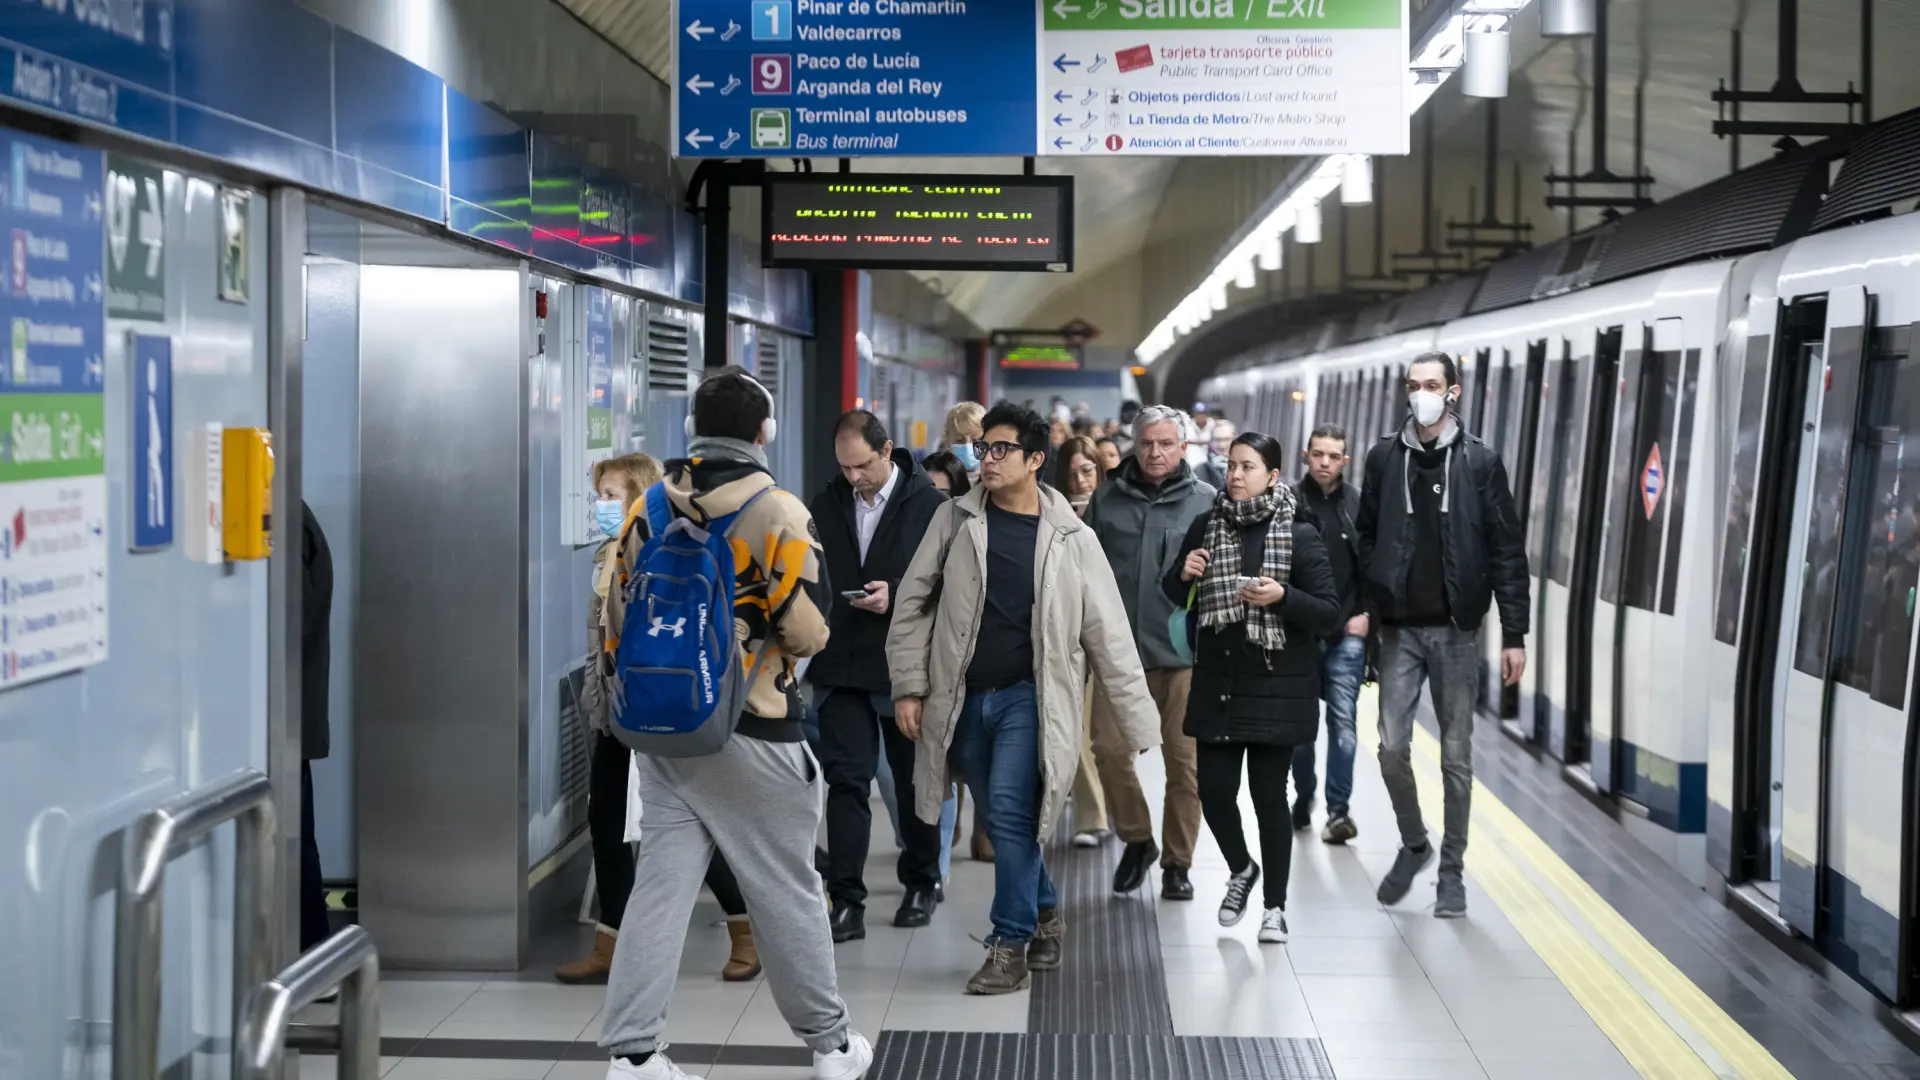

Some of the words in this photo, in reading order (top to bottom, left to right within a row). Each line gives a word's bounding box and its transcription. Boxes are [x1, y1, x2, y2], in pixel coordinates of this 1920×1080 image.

[797, 0, 843, 15] Pinar
[849, 0, 871, 15] de
[764, 5, 779, 36] 1
[797, 25, 902, 41] Valdecarros
[1160, 46, 1206, 60] tarjeta
[1211, 46, 1282, 60] transporte
[1286, 44, 1333, 60] público
[797, 53, 840, 69] Paco
[846, 53, 868, 69] de
[874, 52, 920, 69] Lucía
[760, 58, 783, 90] 9
[1160, 64, 1199, 77] Public
[1204, 64, 1259, 79] Transport
[1263, 63, 1293, 77] Card
[1296, 63, 1333, 77] Office
[797, 79, 871, 98] Arganda
[877, 79, 903, 95] del
[909, 79, 943, 98] Rey
[1128, 91, 1179, 105] Objetos
[1275, 90, 1300, 102] and
[796, 107, 870, 123] Terminal
[876, 107, 967, 123] autobuses
[1128, 113, 1144, 125] La
[1147, 113, 1190, 125] Tienda
[1193, 113, 1209, 125] de
[1277, 113, 1312, 125] Metro
[1314, 112, 1346, 128] Shop
[796, 133, 828, 149] Bus
[833, 133, 899, 149] terminal
[1129, 136, 1181, 148] Atención
[1185, 136, 1195, 148] al
[1299, 136, 1348, 148] Attention
[699, 650, 714, 704] ARMOUR
